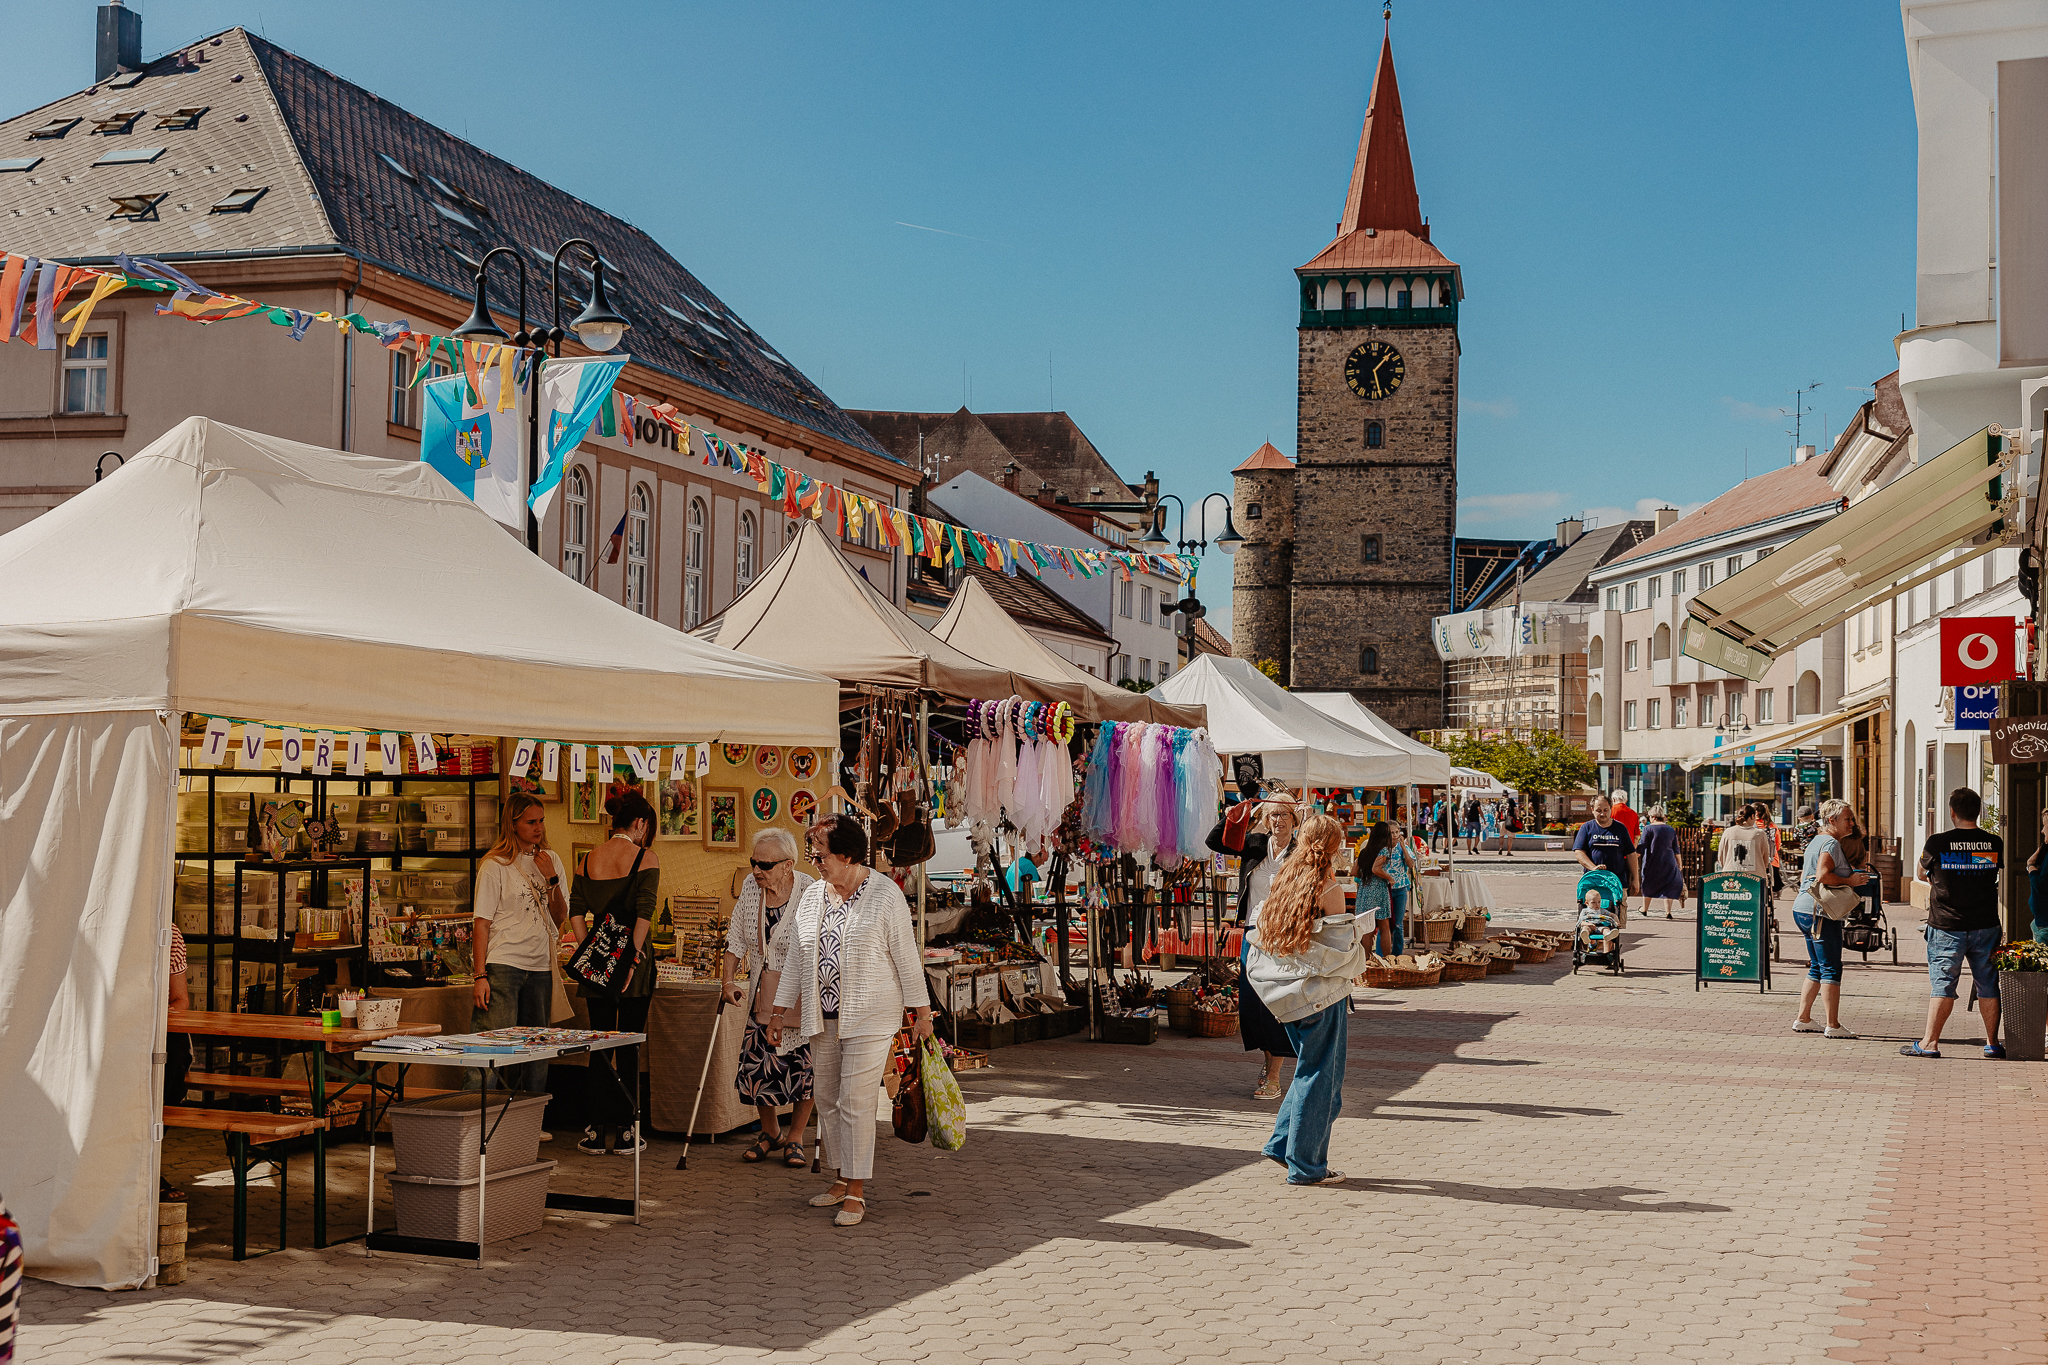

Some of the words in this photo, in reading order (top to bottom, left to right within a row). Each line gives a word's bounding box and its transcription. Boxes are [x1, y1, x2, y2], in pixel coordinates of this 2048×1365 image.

[1522, 613, 1533, 645] KVK
[1995, 728, 2005, 740] U
[2007, 720, 2048, 735] Medvíd
[210, 730, 434, 767] TVOŘIVÁ
[515, 747, 708, 774] DÍLNIČKA
[1950, 841, 1993, 851] INSTRUCTOR
[1710, 891, 1753, 901] BERNARD
